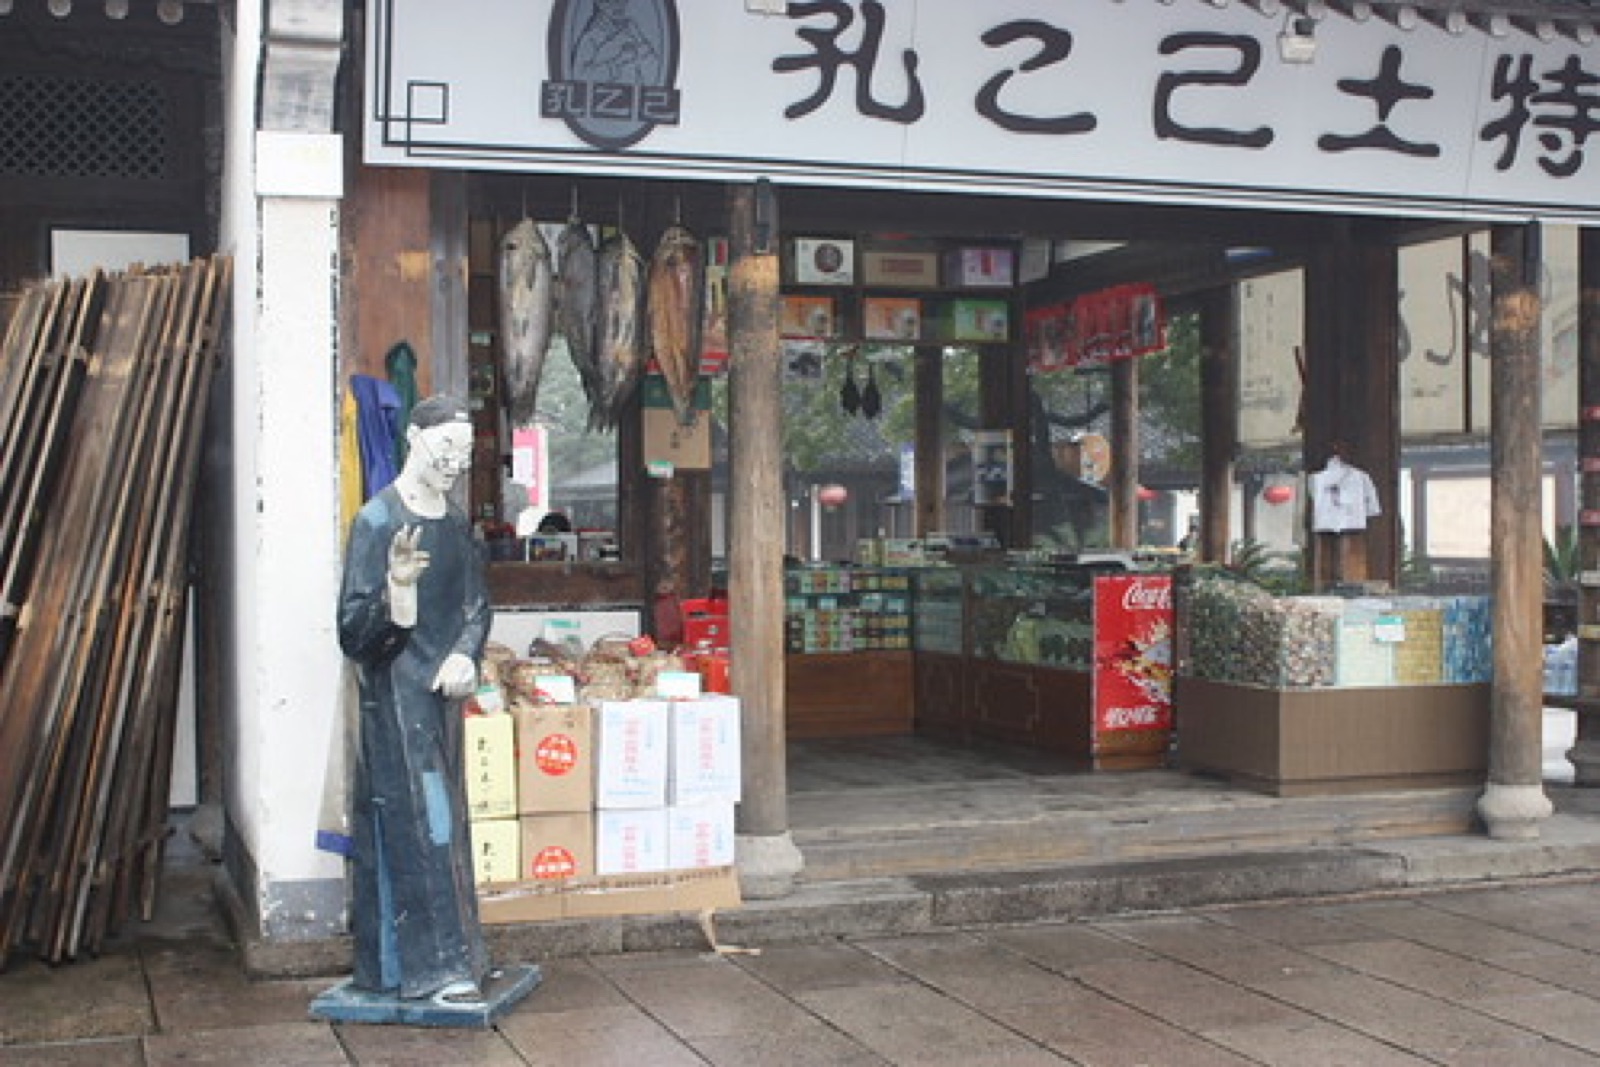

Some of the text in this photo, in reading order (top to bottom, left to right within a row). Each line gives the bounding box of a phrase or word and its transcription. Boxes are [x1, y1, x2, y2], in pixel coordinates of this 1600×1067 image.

[547, 85, 675, 119] 孔乙己
[773, 0, 1600, 176] 孔乙己土特
